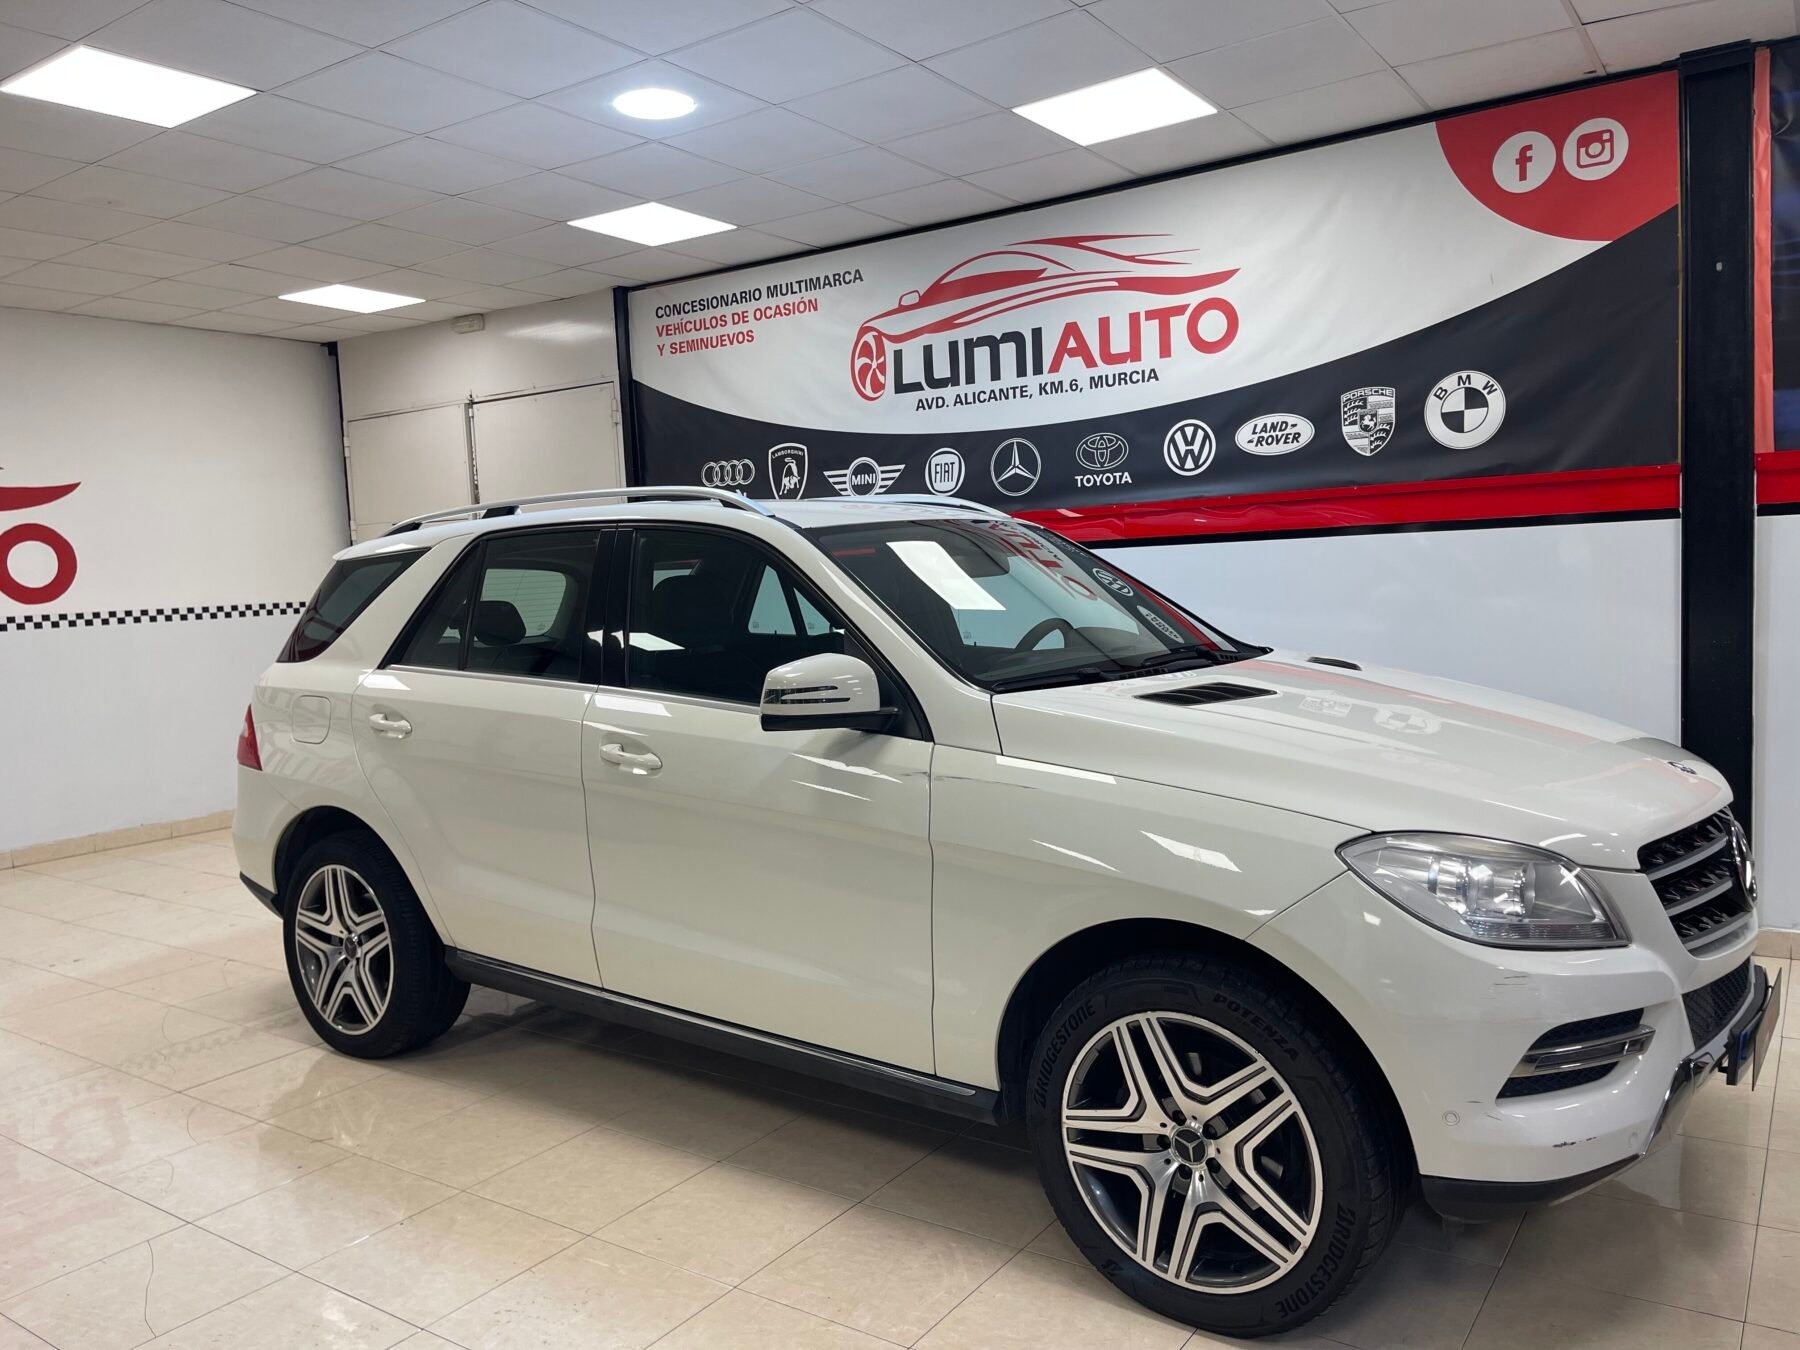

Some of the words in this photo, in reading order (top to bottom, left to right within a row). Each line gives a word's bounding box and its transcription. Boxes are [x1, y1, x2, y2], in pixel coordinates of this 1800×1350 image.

[655, 287, 762, 319] CONCESIONARIO
[766, 268, 864, 299] MULTIMARCA
[656, 314, 728, 338] VEHÍCULOS
[731, 310, 750, 325] DE
[753, 297, 818, 322] OCASIÓN
[657, 343, 666, 357] Y
[669, 329, 755, 355] SEMINUEVOS
[915, 396, 949, 412] AVD.
[953, 384, 1033, 408] ALICANTE,
[1038, 378, 1084, 397] KM.6,
[1088, 367, 1160, 390] MURCIA
[1343, 388, 1394, 402] PORSCHE
[1433, 374, 1498, 401] BMW
[851, 473, 876, 486] MINI
[933, 460, 956, 485] FIAT
[1074, 471, 1133, 488] TOYOTA
[1212, 993, 1300, 1063] POTENZA
[1033, 1001, 1097, 1110] BRIDGESTONE
[1276, 1202, 1357, 1319] BRIDGESTONE
